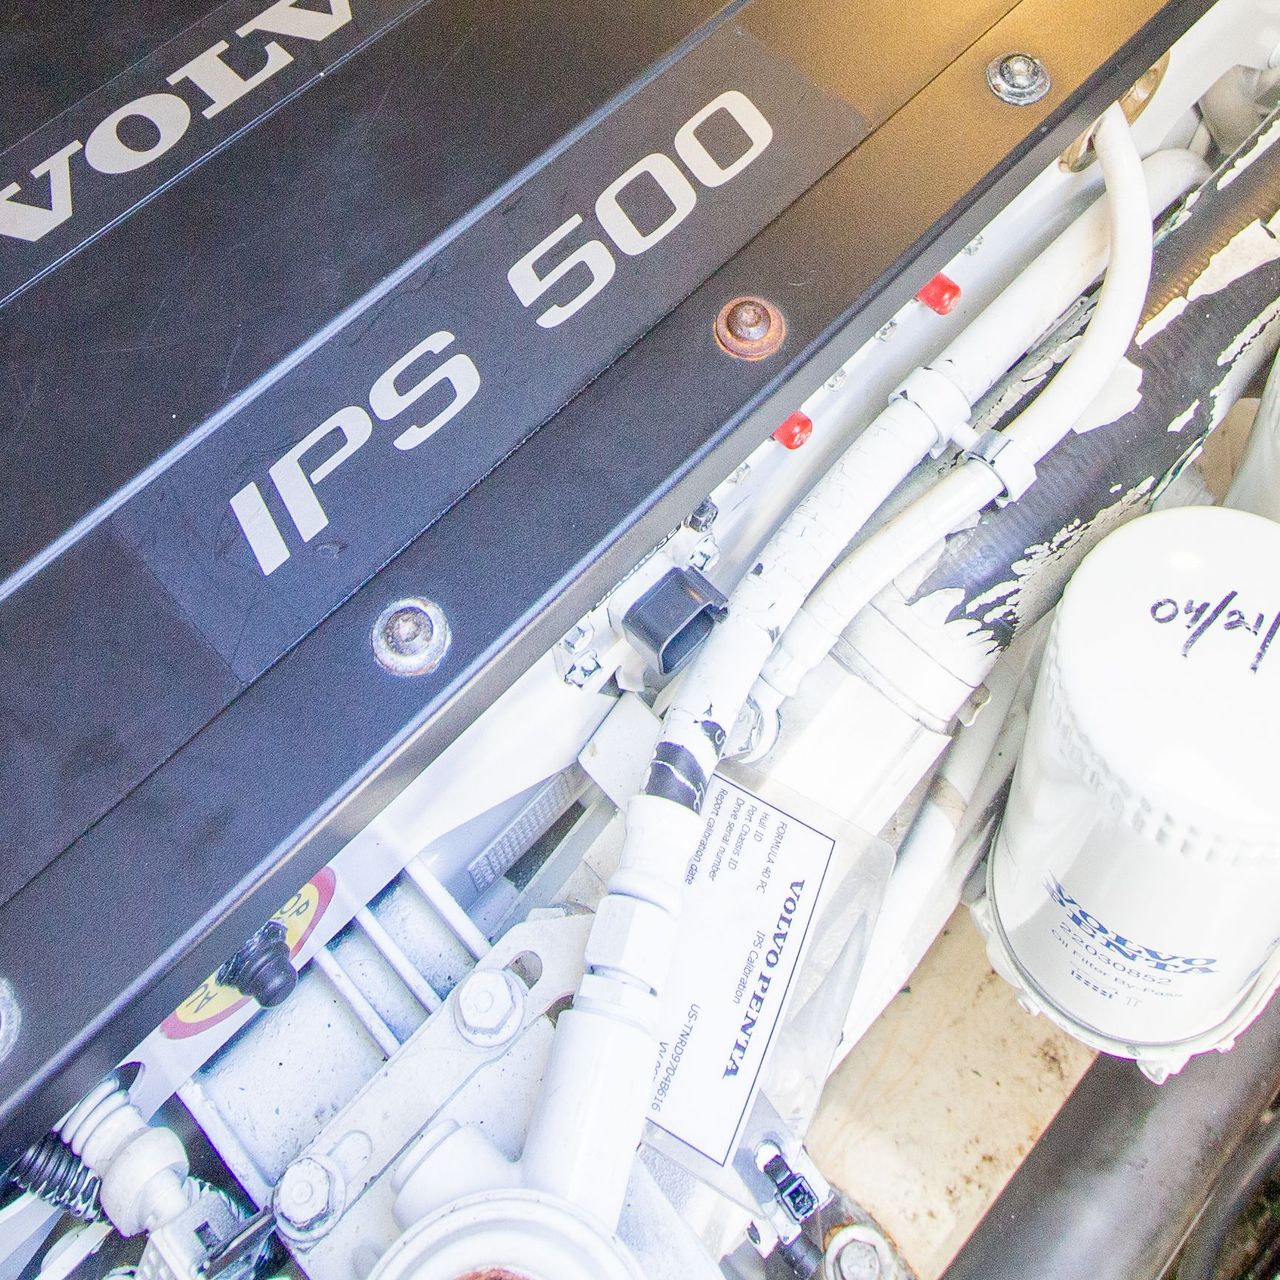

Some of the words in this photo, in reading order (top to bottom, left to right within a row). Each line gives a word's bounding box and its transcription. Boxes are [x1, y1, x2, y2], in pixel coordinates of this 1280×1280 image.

[229, 330, 481, 576] IPS
[506, 90, 773, 328] 500
[708, 786, 728, 817] Report
[729, 796, 745, 820] Drive
[743, 803, 758, 823] Port
[756, 810, 771, 830] Hull
[692, 815, 718, 864] calibration
[720, 819, 737, 846] serial
[730, 822, 751, 858] Chassis
[752, 829, 764, 843] ID
[763, 819, 789, 866] FORMULA
[683, 862, 700, 886] date
[706, 844, 728, 882] number
[726, 856, 739, 871] ID
[759, 864, 772, 879] 40
[755, 877, 768, 894] PC
[764, 878, 806, 969] VOLVO
[1043, 882, 1219, 973] PENTA
[1049, 870, 1217, 966] VOLVO
[751, 929, 766, 949] IPS
[1051, 929, 1069, 948] Oil
[1073, 950, 1109, 977] Filter
[1059, 921, 1172, 985] 22030852
[733, 949, 760, 1005] Calibration
[722, 971, 773, 1080] PENTA
[651, 1002, 701, 1113] US-TNRD9704B616
